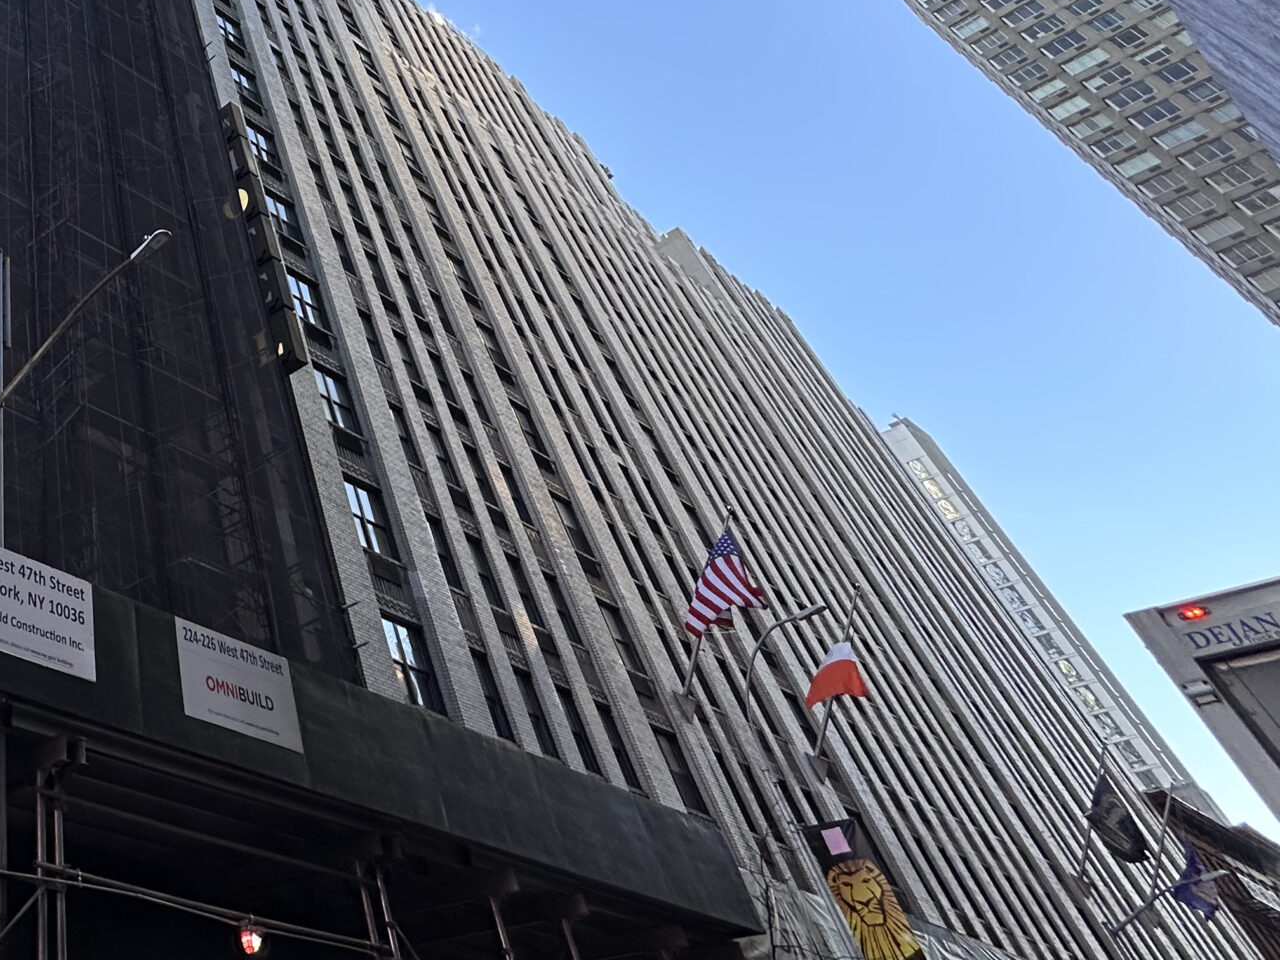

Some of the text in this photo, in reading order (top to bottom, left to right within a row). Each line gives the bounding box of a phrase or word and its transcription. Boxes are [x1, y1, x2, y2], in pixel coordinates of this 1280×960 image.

[18, 564, 46, 587] 47th
[49, 576, 85, 601] Street
[28, 591, 45, 610] NY
[49, 600, 85, 625] 10036
[10, 616, 67, 646] Construction
[69, 637, 84, 651] Inc.
[182, 626, 283, 676] 224-226 West 47th Street
[205, 675, 274, 711] OMNIBUILD
